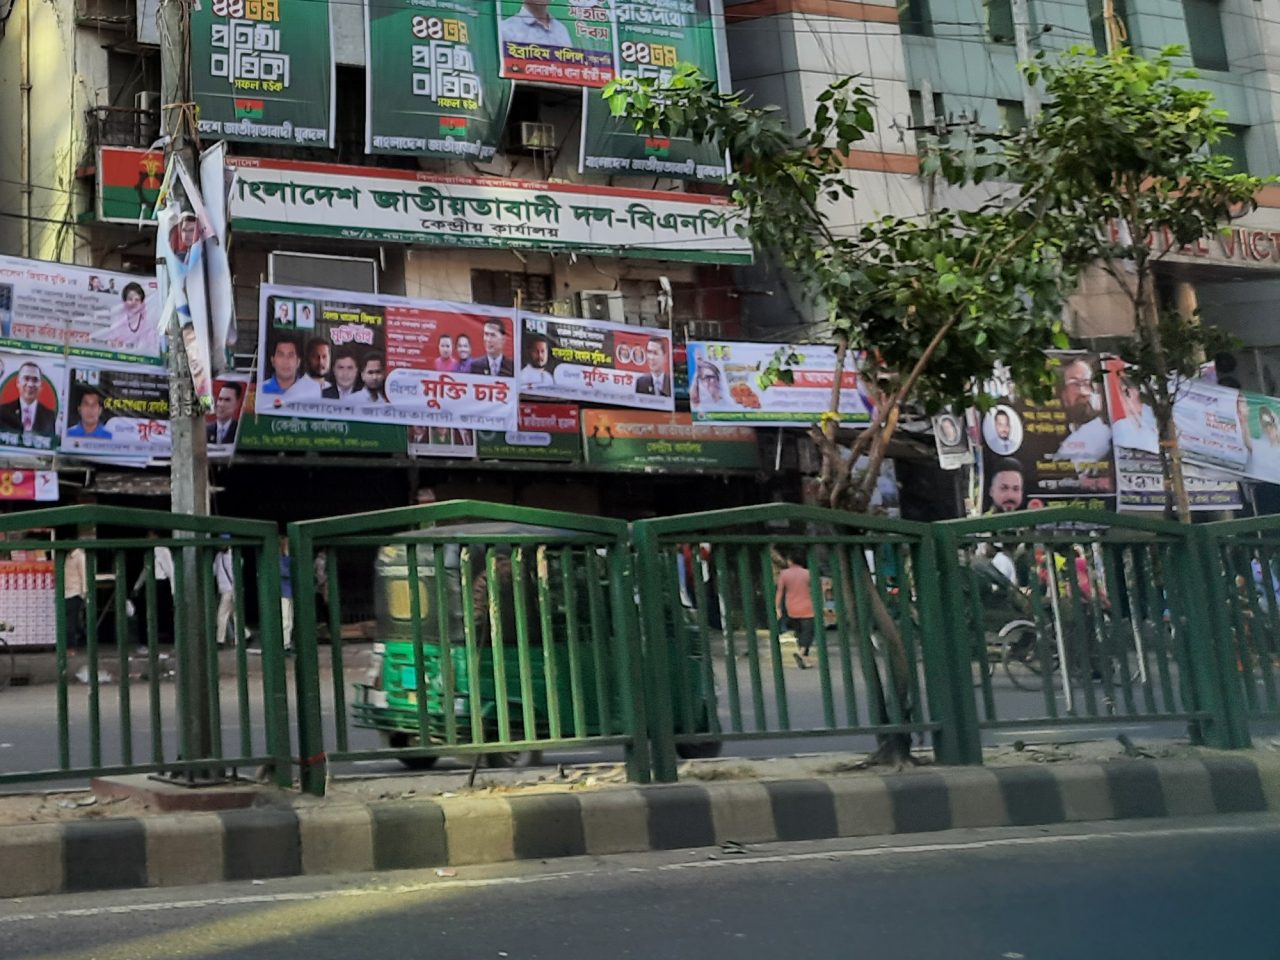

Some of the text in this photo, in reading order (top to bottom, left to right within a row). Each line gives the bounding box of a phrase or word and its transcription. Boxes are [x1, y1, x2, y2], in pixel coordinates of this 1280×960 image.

[412, 16, 469, 44] ৪৪তম
[575, 21, 608, 40] দিবস
[507, 42, 550, 60] ইব্রাহিম
[621, 41, 677, 68] ৪৪তম
[234, 79, 259, 90] সফল
[223, 118, 293, 138] জাতীয়তাবাদী
[373, 136, 426, 151] বাংলাদেশ
[585, 156, 631, 169] বাংলাদেশ
[632, 156, 695, 176] জাতীয়তাবাদী
[236, 176, 731, 237] াংলাদেশ জাতীয়তাবাদী দল-বিএনপি
[420, 218, 560, 238] কেন্দ্রীয় কার্যালয়
[582, 367, 635, 389] মুক্তি চাই
[420, 374, 468, 410] মুক্তি
[472, 381, 510, 404] চাই
[286, 402, 354, 416] বাংলাদেশ
[360, 406, 454, 424] জাতীয়তাবাদী
[137, 418, 167, 441] মুক্তি
